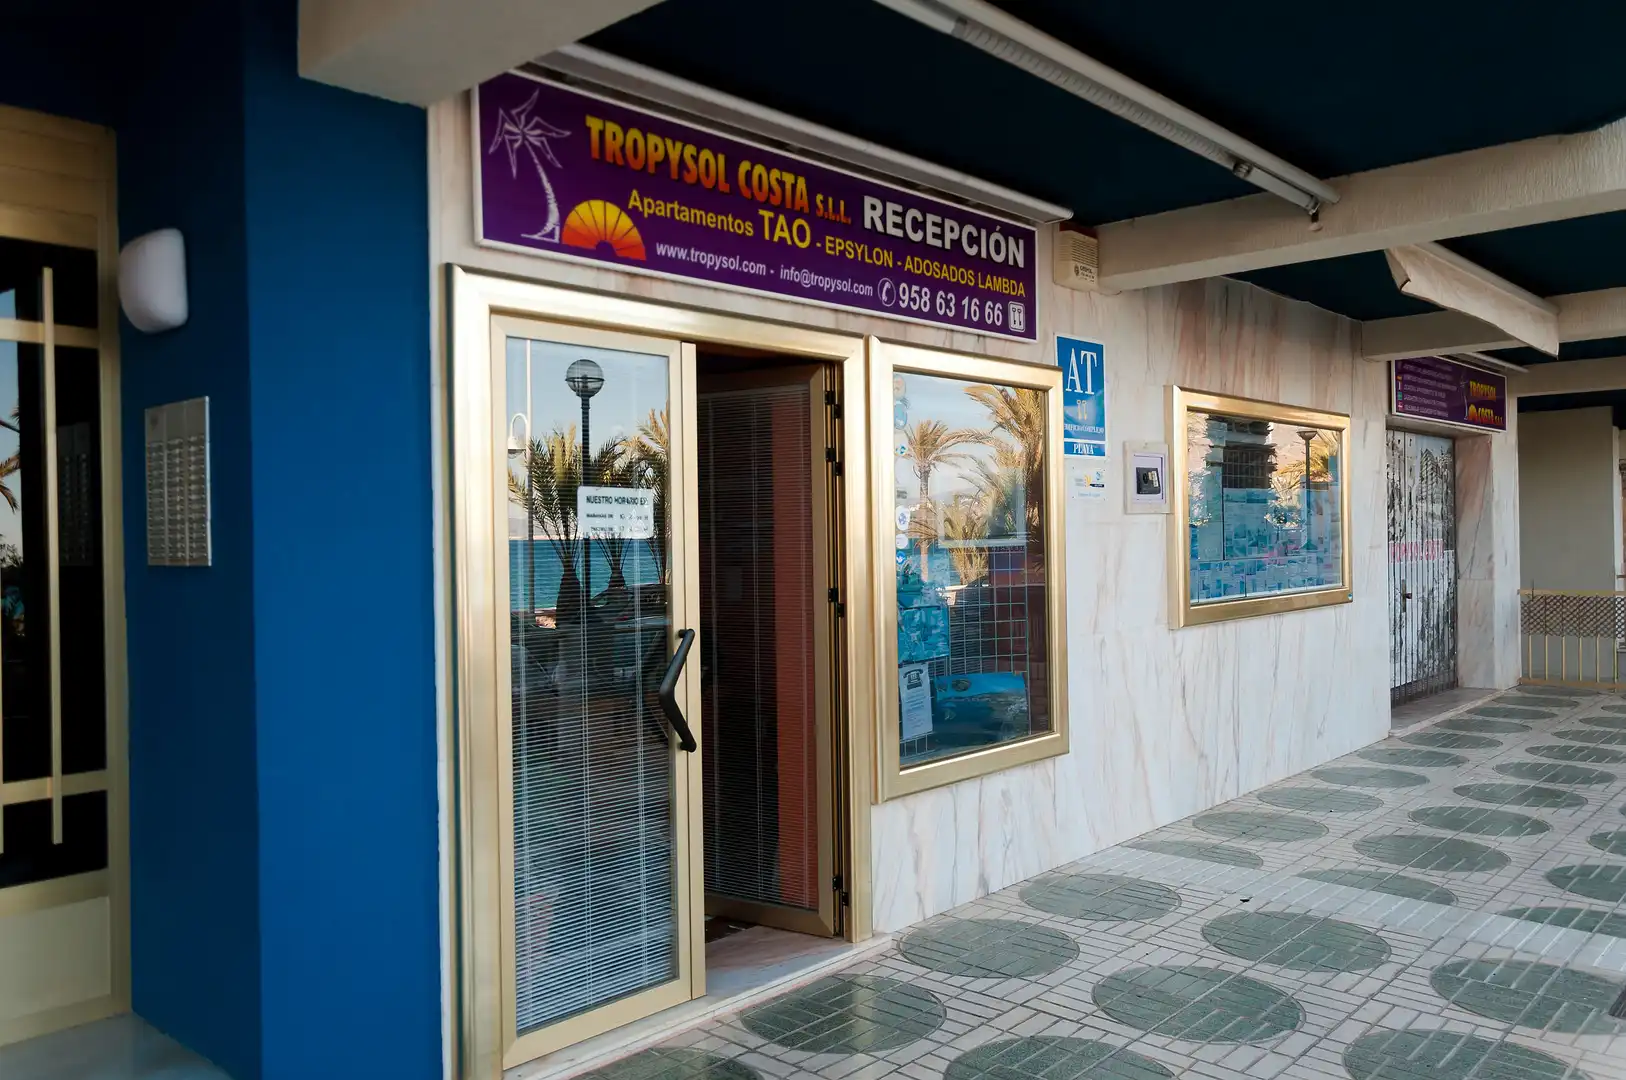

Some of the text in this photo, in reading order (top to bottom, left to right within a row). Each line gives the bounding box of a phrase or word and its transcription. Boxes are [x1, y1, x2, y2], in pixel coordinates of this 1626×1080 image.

[585, 114, 731, 194] TROPYSOL
[737, 160, 810, 214] COSTA
[628, 189, 754, 237] Apartamentos
[758, 209, 811, 249] TAO
[825, 235, 893, 269] EPSYLON
[904, 255, 975, 287] ADOSADOS
[977, 272, 1026, 298] LAMBDA
[863, 195, 1025, 269] RECEPCIÓN
[656, 242, 767, 276] www.tropysol.com
[780, 264, 874, 298] info@tropysol.com
[898, 282, 931, 312] 958
[935, 290, 956, 318] 63
[961, 296, 980, 322] 16
[984, 300, 1004, 326] 66
[1065, 347, 1098, 395] AT
[1072, 443, 1095, 455] PLAYA
[586, 496, 613, 505] NUESTRO
